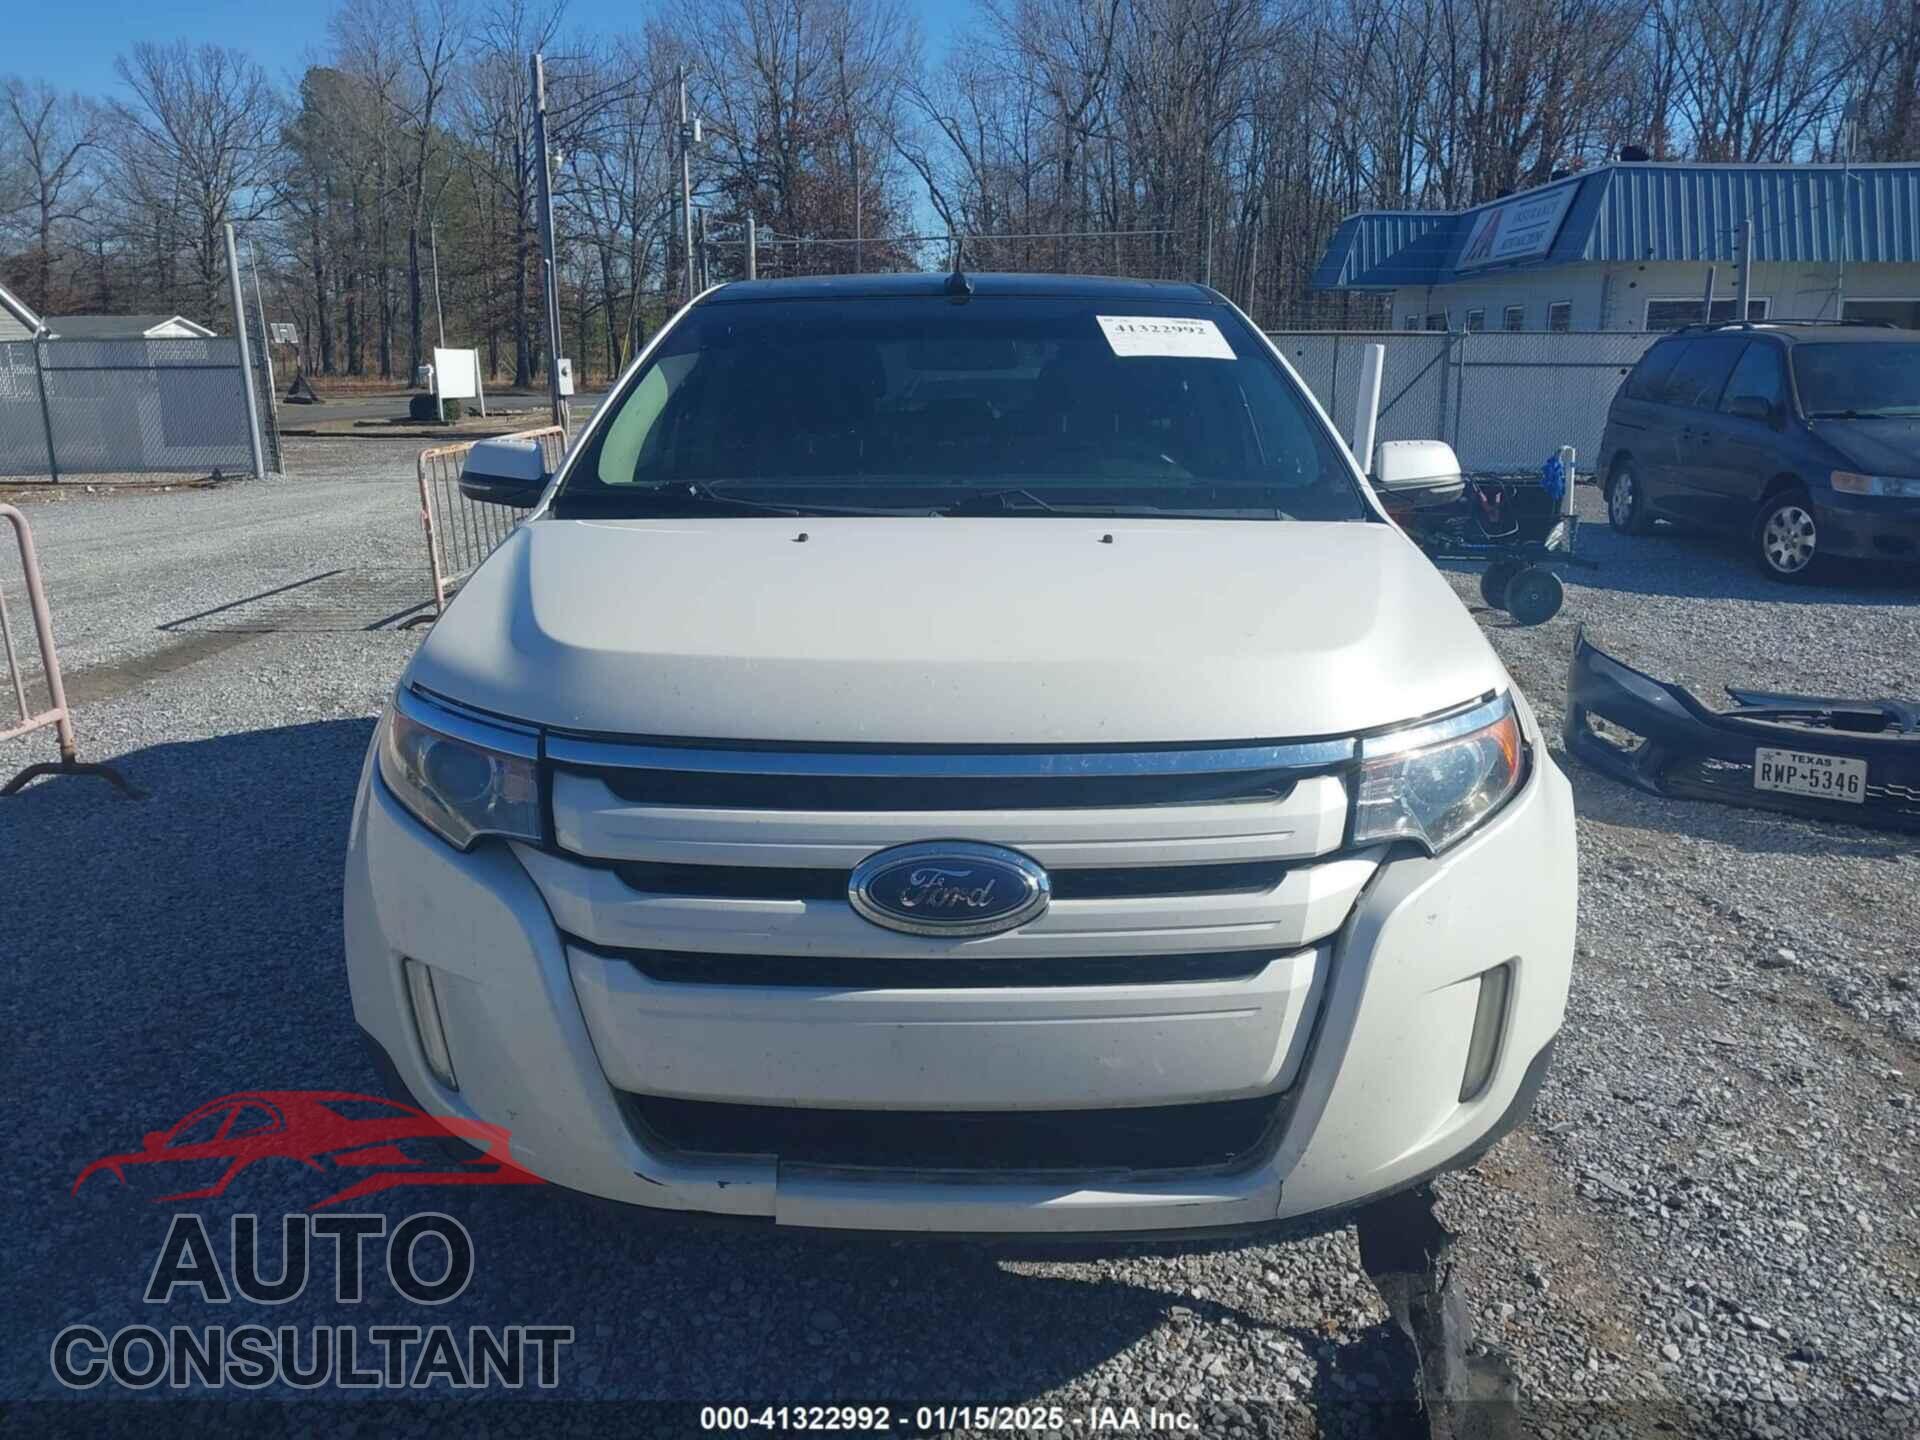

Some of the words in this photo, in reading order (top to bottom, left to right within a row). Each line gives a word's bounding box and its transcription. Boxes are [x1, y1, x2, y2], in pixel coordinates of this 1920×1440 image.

[1114, 324, 1207, 336] 41322992
[1791, 753, 1832, 767] TEXAS
[902, 868, 995, 908] Ford
